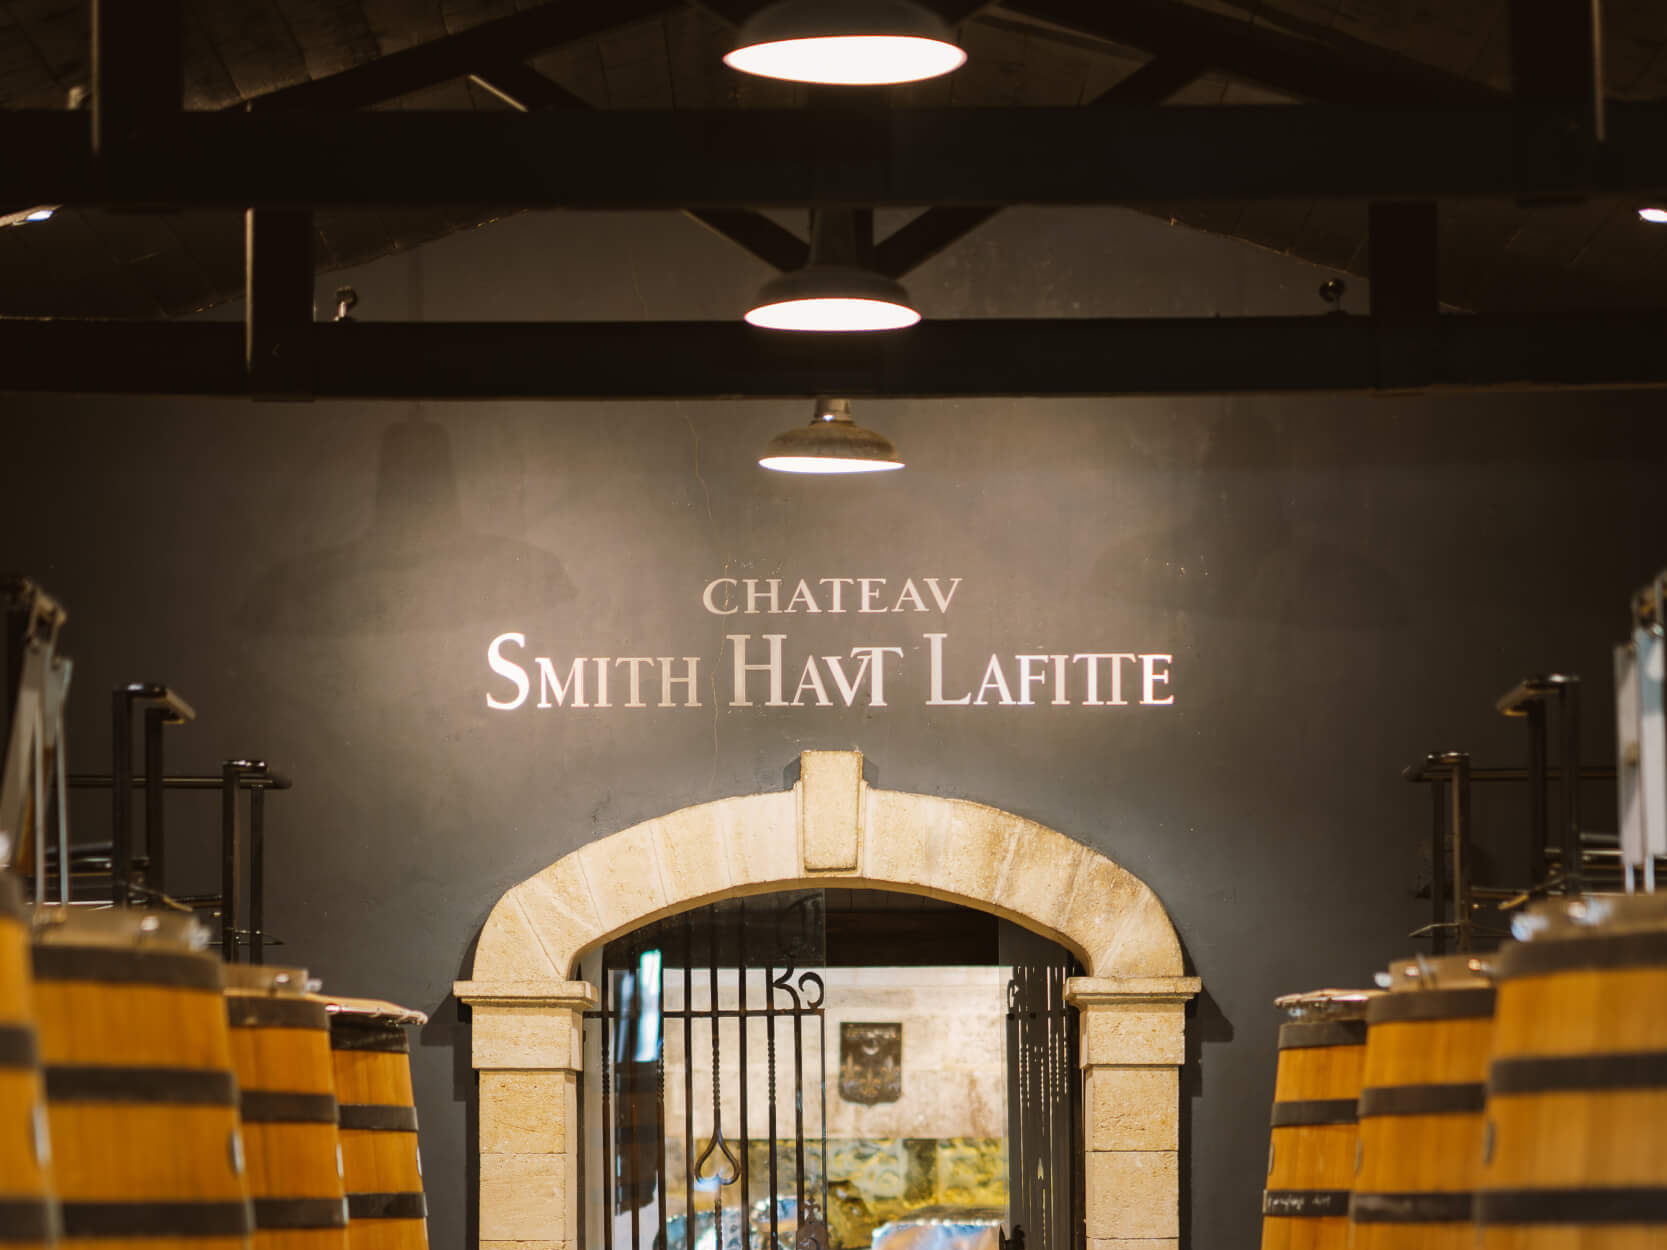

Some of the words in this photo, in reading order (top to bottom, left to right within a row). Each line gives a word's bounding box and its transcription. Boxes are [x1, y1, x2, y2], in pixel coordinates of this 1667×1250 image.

[702, 577, 963, 614] CHATEAV
[485, 631, 702, 711] SMITH
[921, 632, 1175, 707] LAFITTE
